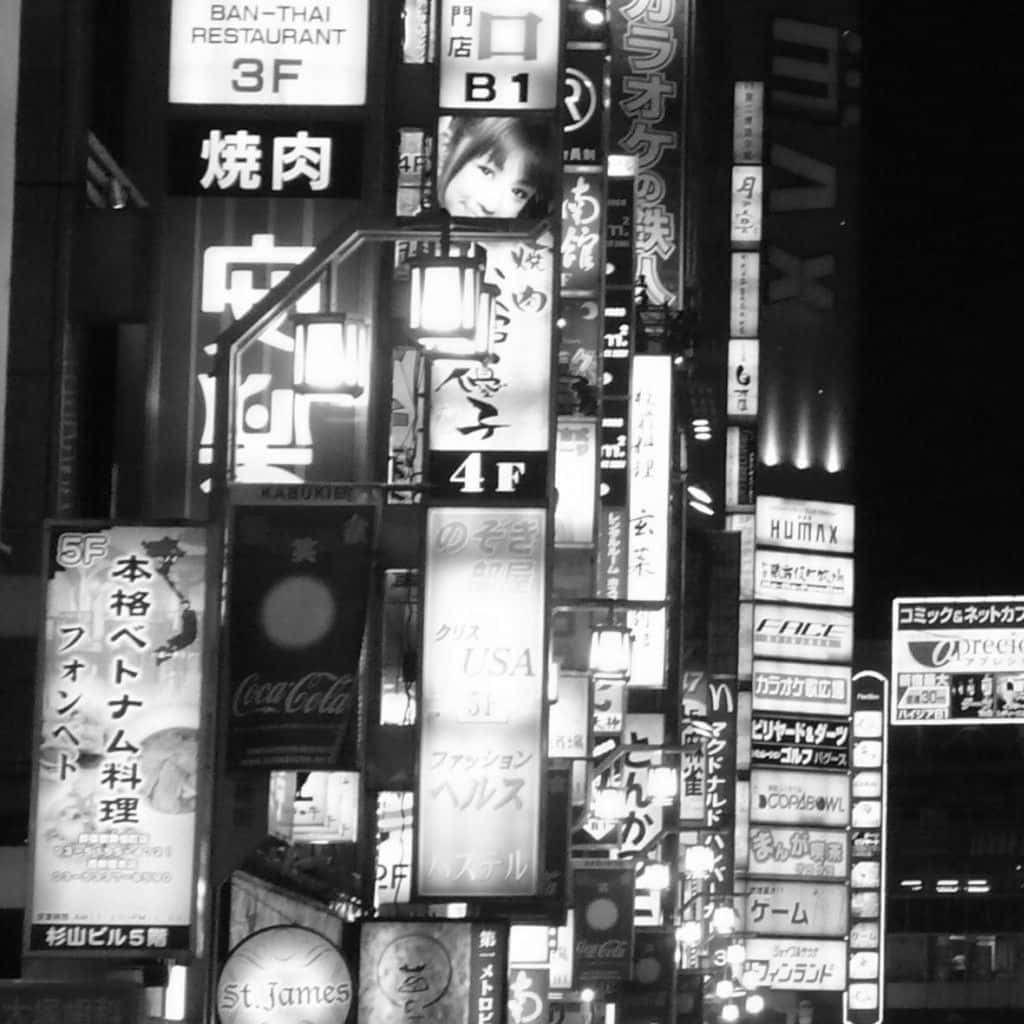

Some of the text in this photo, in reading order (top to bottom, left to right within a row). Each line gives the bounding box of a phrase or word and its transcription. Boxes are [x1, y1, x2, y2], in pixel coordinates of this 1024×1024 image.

[210, 4, 331, 23] BAN-THAI
[192, 27, 346, 46] RESTAURANT
[231, 59, 303, 93] 3F
[464, 72, 531, 103] B1
[200, 129, 333, 192] 焼肉
[449, 453, 526, 493] 4F
[56, 533, 110, 566] 5F
[99, 554, 152, 825] 本格ベトナム料理
[705, 721, 727, 826] マクドナルド
[45, 925, 168, 948] 杉山ビル5階
